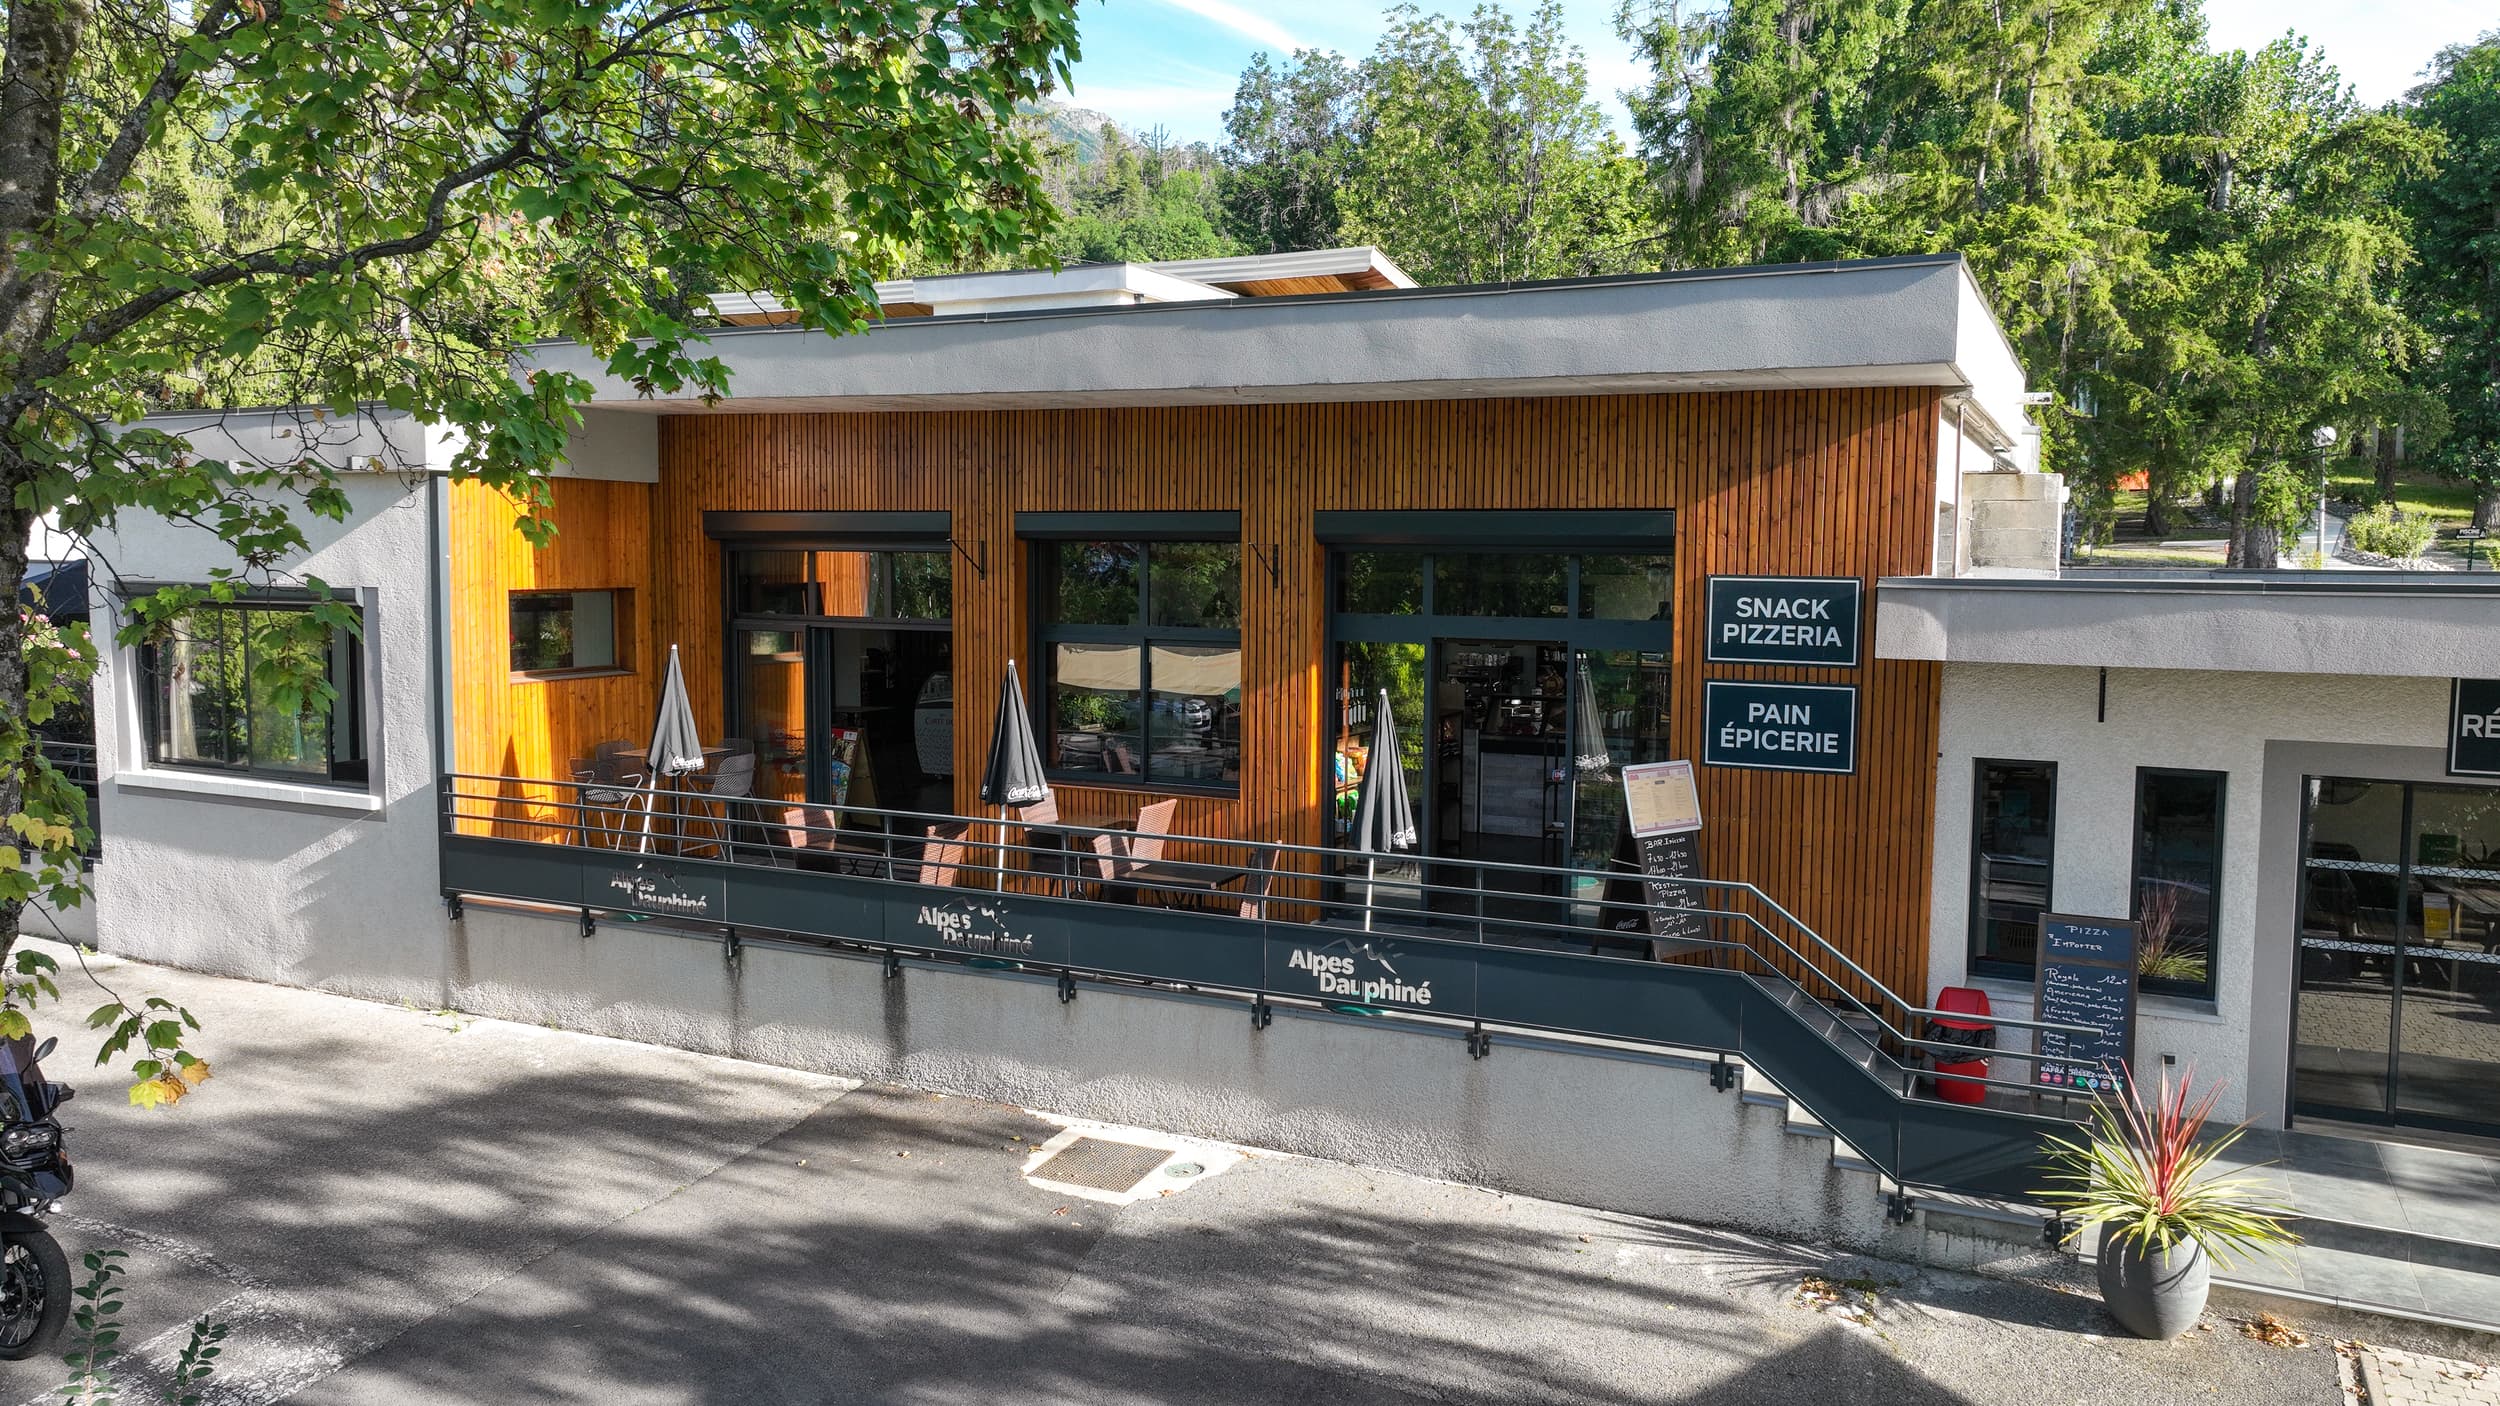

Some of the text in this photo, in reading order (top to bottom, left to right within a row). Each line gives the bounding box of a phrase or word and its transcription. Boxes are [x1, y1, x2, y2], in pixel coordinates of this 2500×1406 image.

[1735, 597, 1830, 620] SNACK
[1722, 623, 1842, 647] PIZZERIA
[1748, 702, 1810, 726] PAIN
[1720, 721, 1839, 754] ÉPICERIE
[610, 871, 656, 894] Alpes
[917, 905, 972, 932] Alpes
[2064, 925, 2110, 937] PIZZA
[943, 927, 1033, 956] Dauphiné
[1288, 948, 1355, 977] Alpes
[1319, 972, 1432, 1005] Dauphiné
